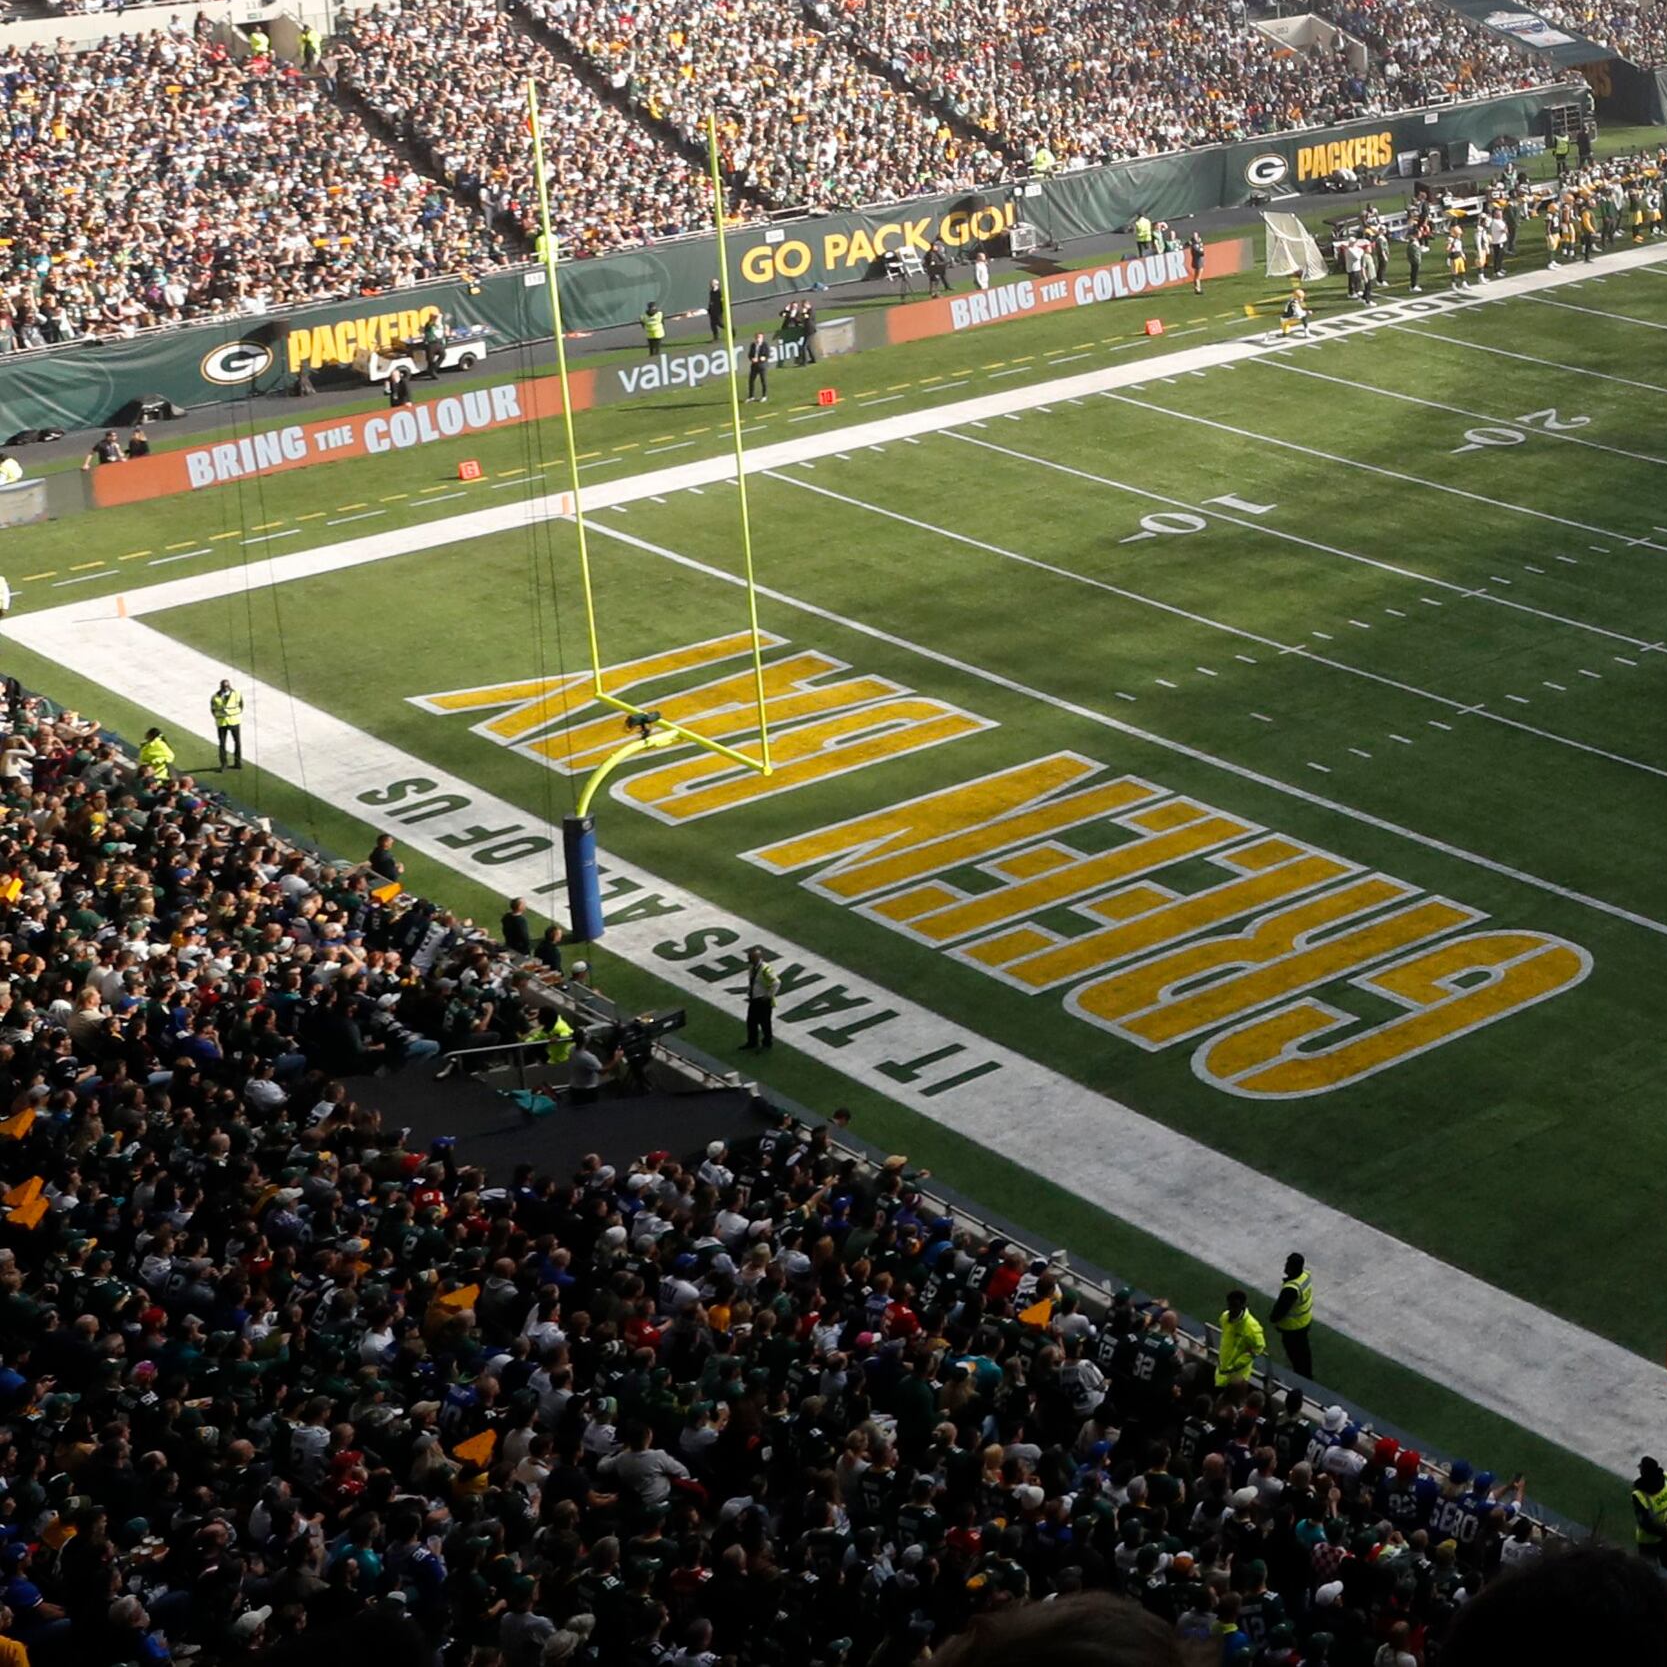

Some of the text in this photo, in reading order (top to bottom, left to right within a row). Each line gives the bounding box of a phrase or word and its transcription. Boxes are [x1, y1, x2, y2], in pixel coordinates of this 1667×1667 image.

[1297, 131, 1393, 182] PACKERS
[741, 202, 1016, 285] GO PACK GO!
[949, 249, 1188, 331] BRING THE COLOUR
[617, 343, 744, 394] valspar
[185, 383, 522, 490] BRING THE COLOUR
[1463, 408, 1592, 448] 20
[1138, 491, 1278, 537] 10
[356, 776, 472, 825] US
[403, 627, 1595, 1102] GREEN BAY
[436, 823, 553, 866] OF
[652, 926, 902, 1050] TAKES
[873, 1040, 1003, 1098] IT
[966, 1264, 988, 1289] 12
[1097, 1341, 1119, 1363] 12
